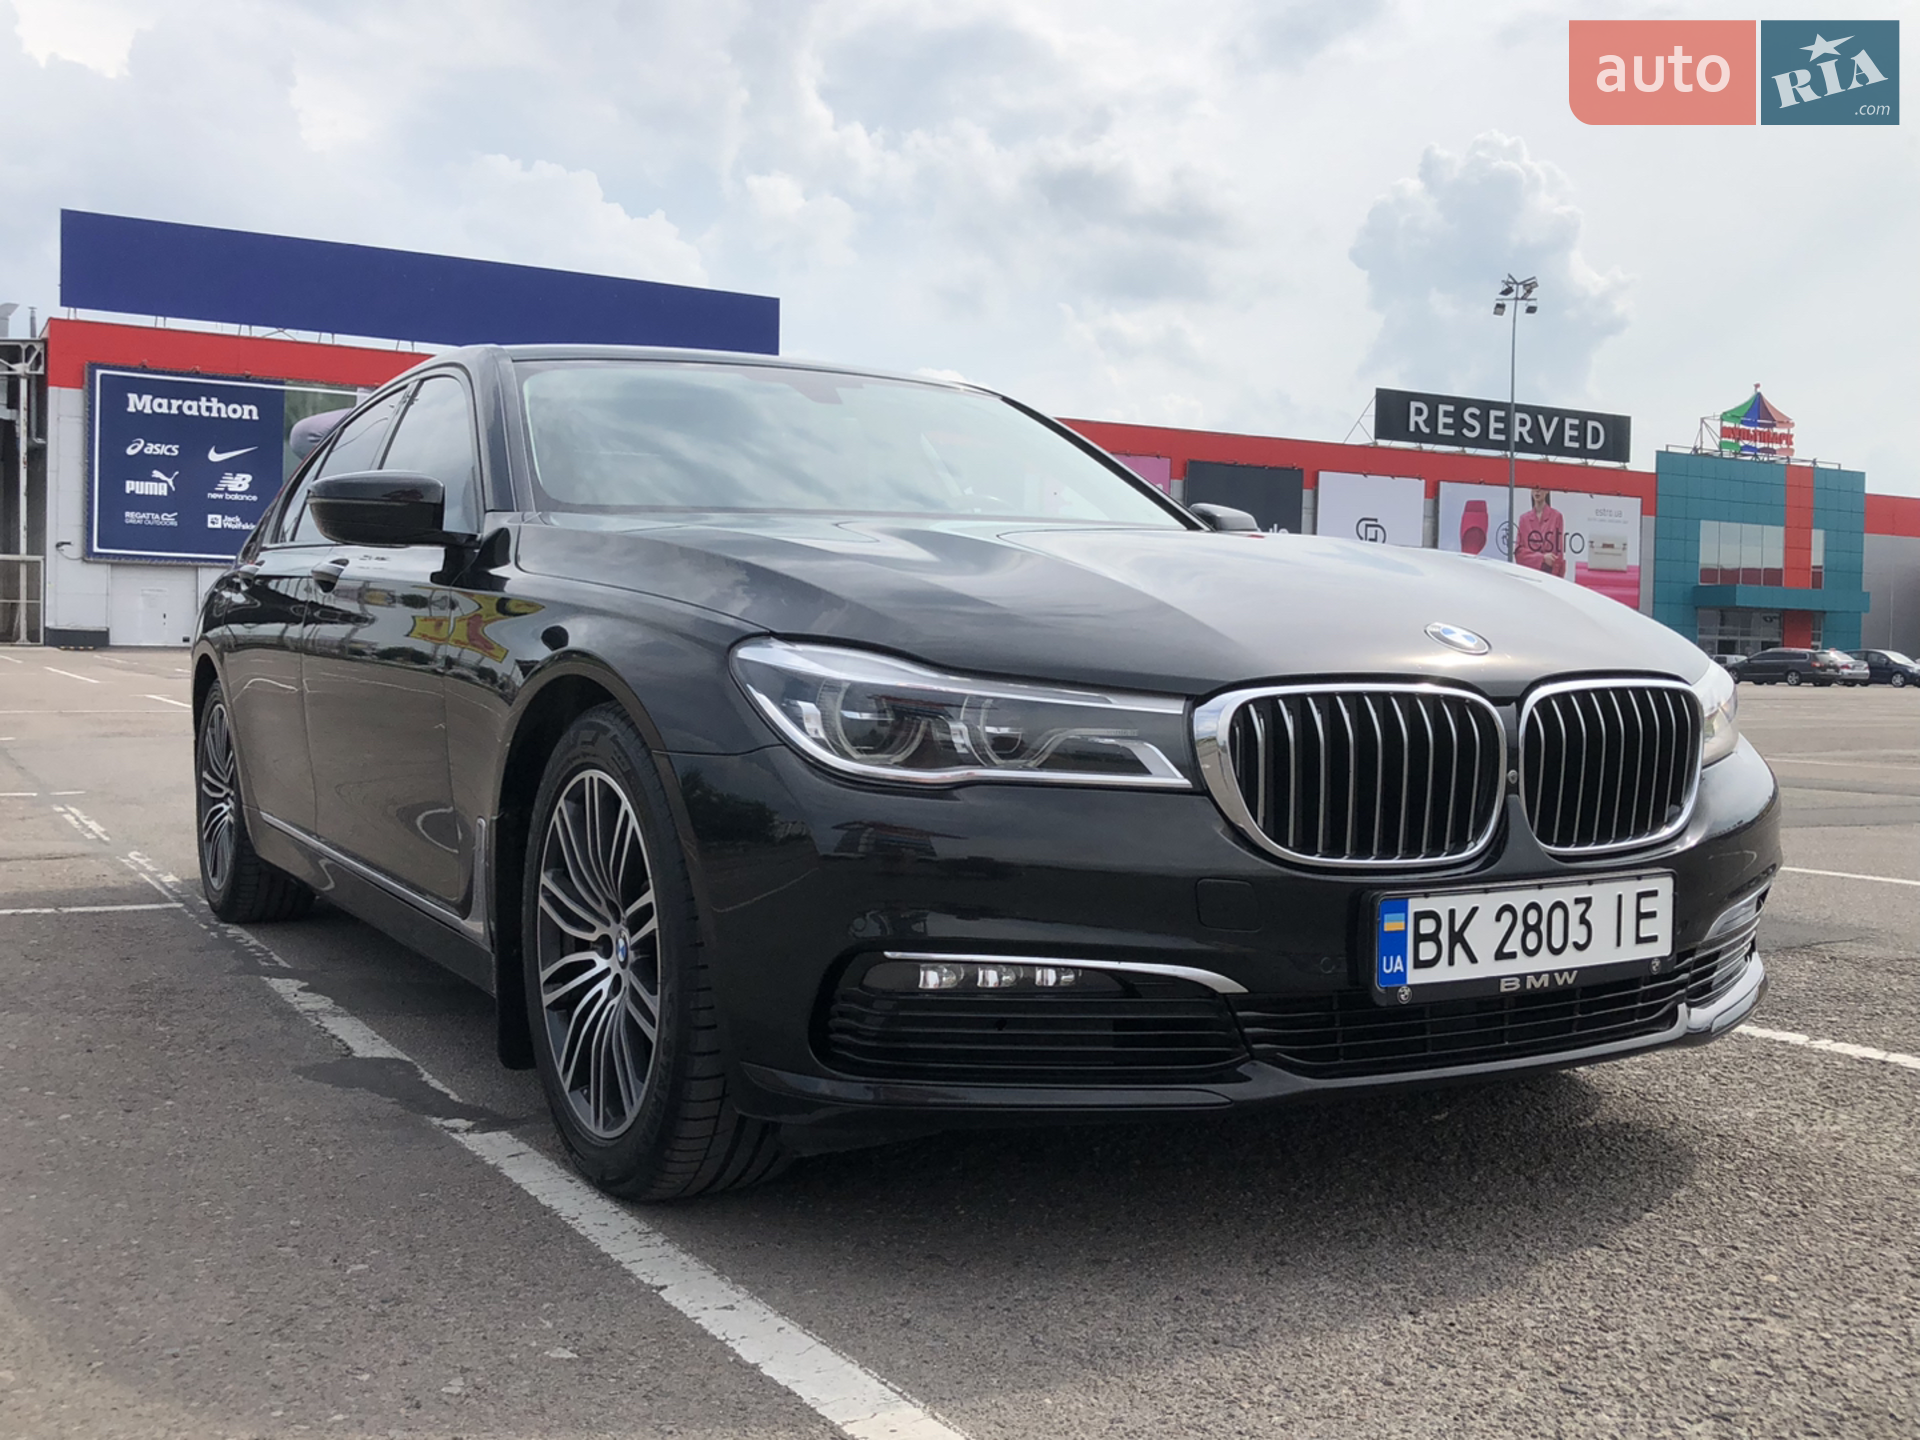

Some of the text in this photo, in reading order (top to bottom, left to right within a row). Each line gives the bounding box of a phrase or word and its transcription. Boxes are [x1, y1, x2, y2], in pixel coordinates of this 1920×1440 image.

[127, 393, 259, 420] Marathon
[1408, 400, 1605, 450] RESERVED
[144, 442, 179, 456] asics
[125, 480, 168, 496] PUMA
[225, 493, 258, 501] balance
[1527, 527, 1585, 554] estro
[1413, 889, 1659, 969] BK 2803 IE
[1383, 955, 1405, 974] UA
[1500, 970, 1579, 993] BMW
